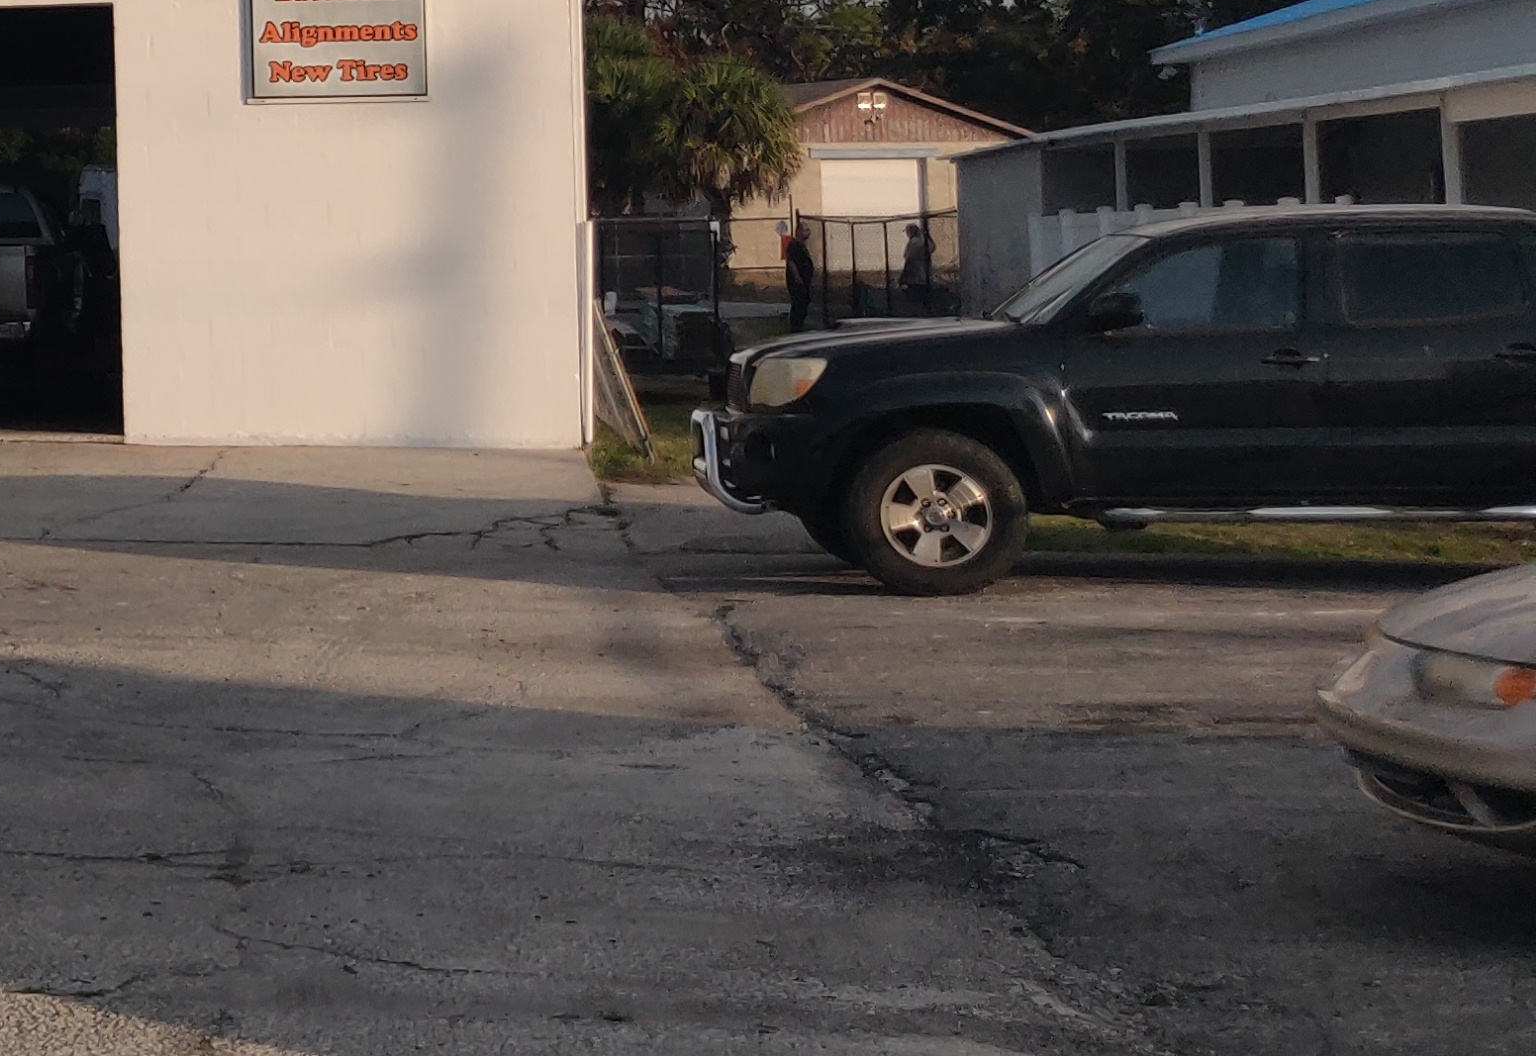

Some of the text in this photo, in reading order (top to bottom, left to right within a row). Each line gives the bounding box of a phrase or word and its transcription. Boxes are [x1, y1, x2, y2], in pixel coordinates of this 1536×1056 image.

[259, 21, 418, 48] Alignments
[268, 59, 409, 83] New Tires
[1102, 411, 1179, 421] TACOMA
